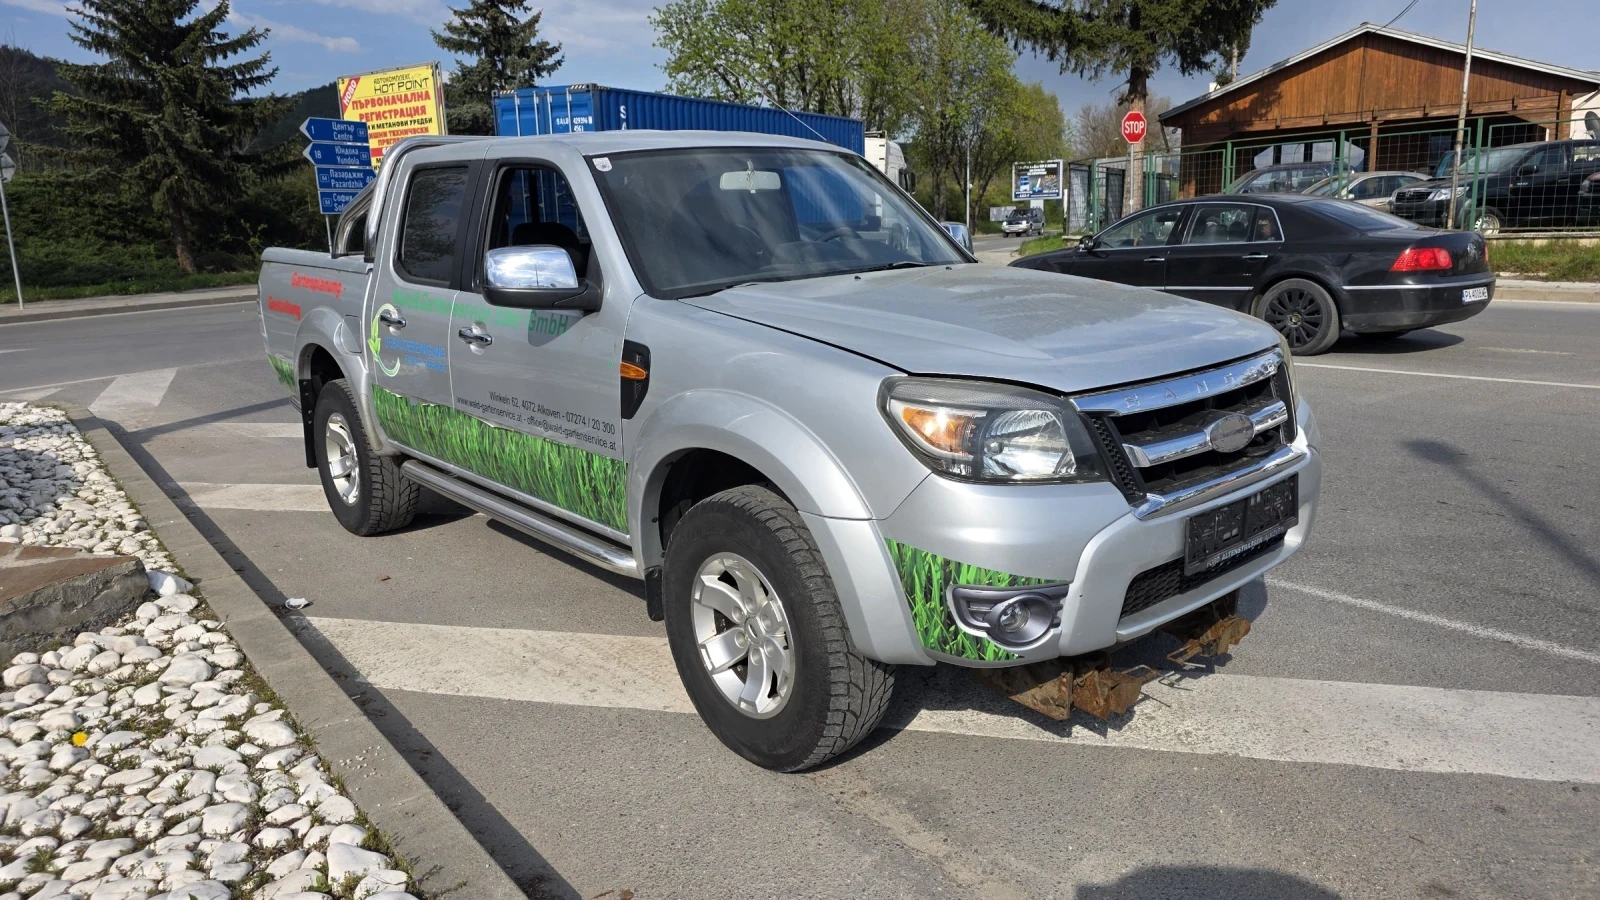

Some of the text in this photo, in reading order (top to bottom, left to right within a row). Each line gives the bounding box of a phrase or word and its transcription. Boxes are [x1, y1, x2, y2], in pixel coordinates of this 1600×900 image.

[342, 79, 356, 106] НОВО
[374, 78, 429, 94] HOT POINT
[352, 90, 430, 110] ПЪРВОНАЧАЛНА
[358, 105, 426, 122] РЕГИСТРАЦИЯ
[311, 126, 315, 134] 1
[332, 122, 354, 132] Център
[376, 120, 409, 130] МЕТАНОВИ
[409, 117, 433, 126] УРЕДБИ
[1124, 121, 1145, 134] STOP
[333, 132, 354, 141] Centre
[314, 150, 322, 159] 18
[334, 146, 359, 155] Юндола
[336, 156, 360, 165] Yundola
[330, 169, 364, 179] Пазарджик
[331, 180, 364, 188] Pazardzhik
[528, 309, 569, 337] GmbH
[511, 396, 520, 409] 62,
[522, 399, 536, 412] 4072
[537, 403, 561, 419] Alkoven
[565, 411, 586, 426] 07274
[592, 418, 600, 430] 20
[602, 421, 616, 435] 300
[526, 415, 617, 451] office@wald-gartenservice.at
